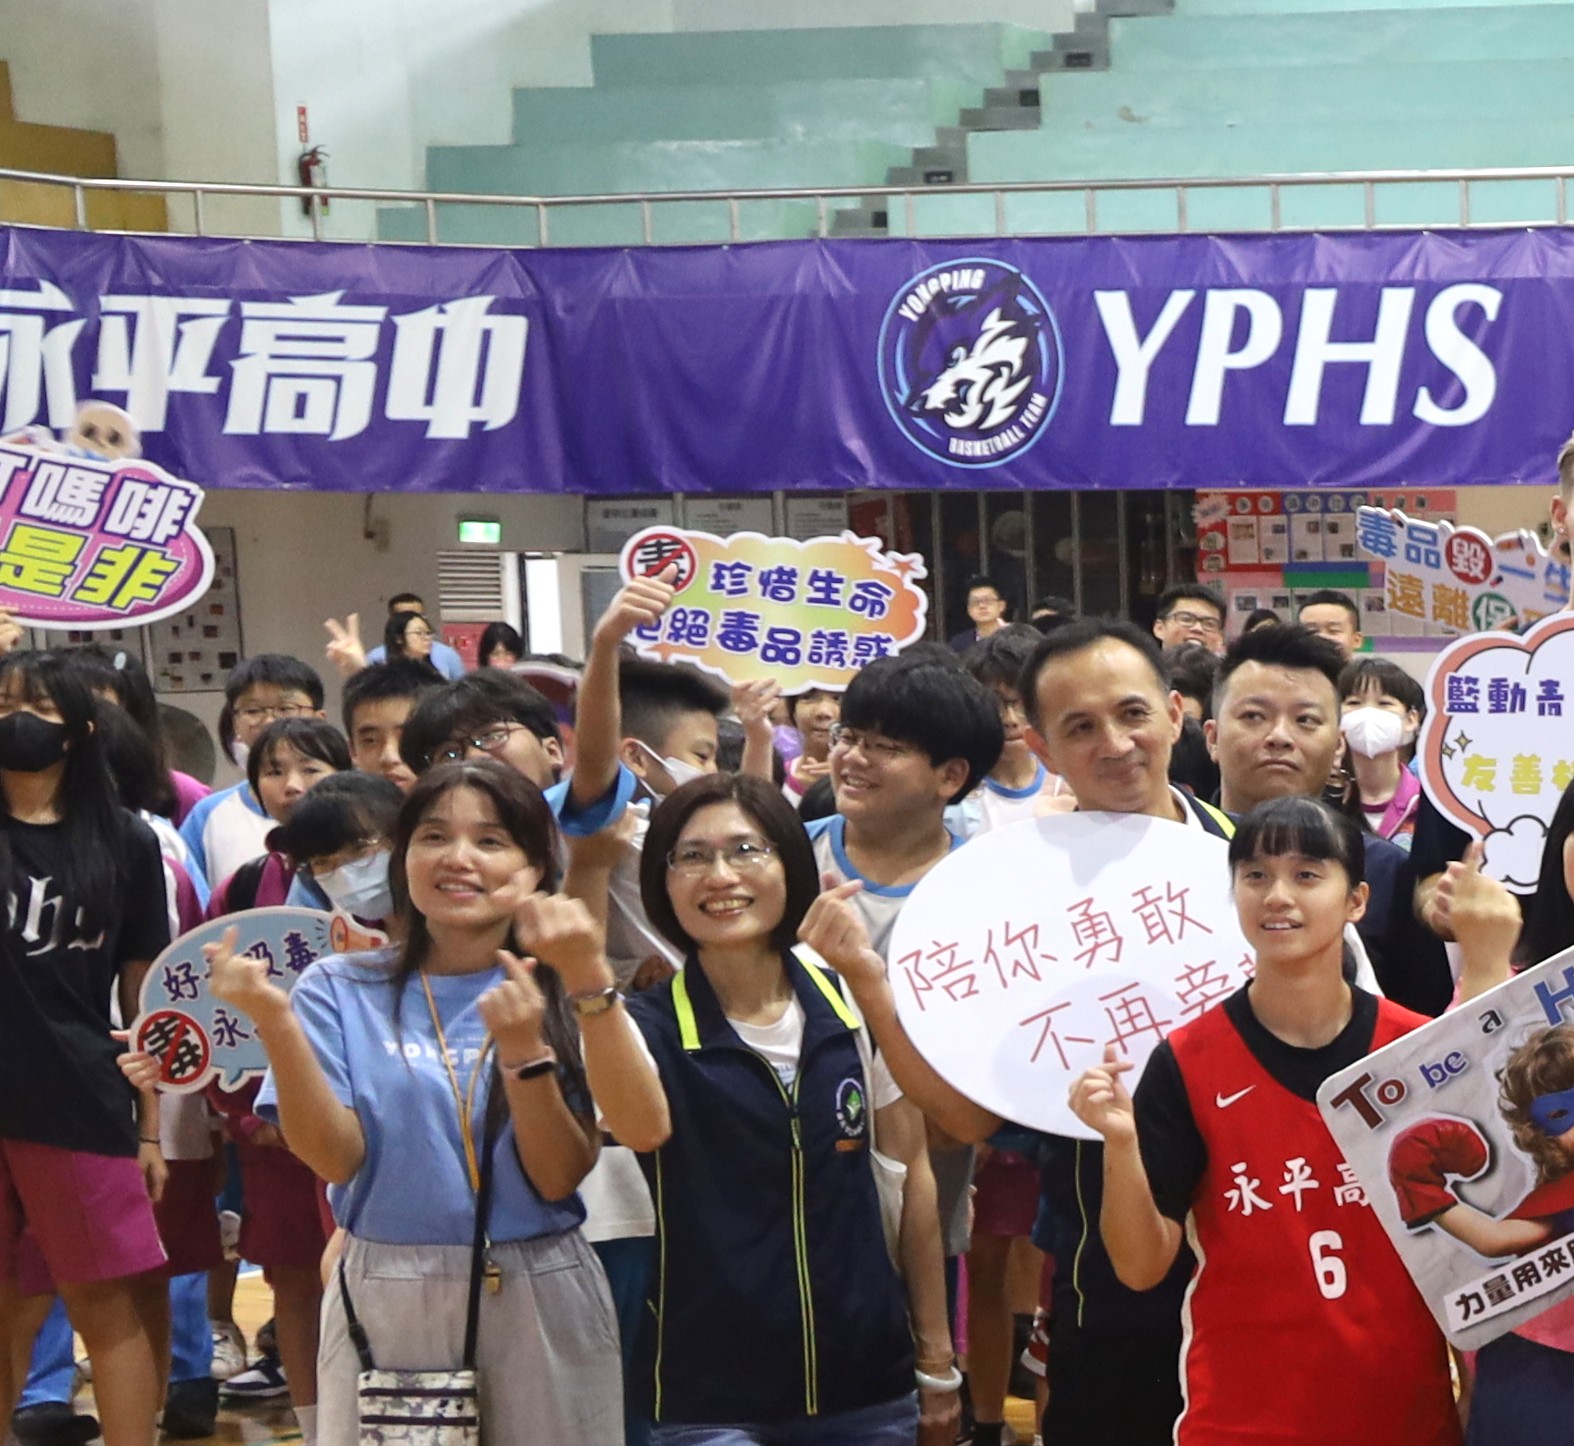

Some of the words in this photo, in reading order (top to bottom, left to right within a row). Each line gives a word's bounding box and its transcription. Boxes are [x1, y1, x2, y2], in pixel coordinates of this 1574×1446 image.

[898, 268, 986, 322] YONGPING
[1093, 283, 1503, 427] YPHS
[709, 560, 894, 620] 珍惜生命
[1386, 573, 1545, 636] 遠離保
[896, 880, 1214, 1013] 陪你勇敢
[1331, 1074, 1409, 1131] To
[1420, 1049, 1468, 1090] be
[1479, 1009, 1504, 1035] a
[1309, 1230, 1347, 1299] 6
